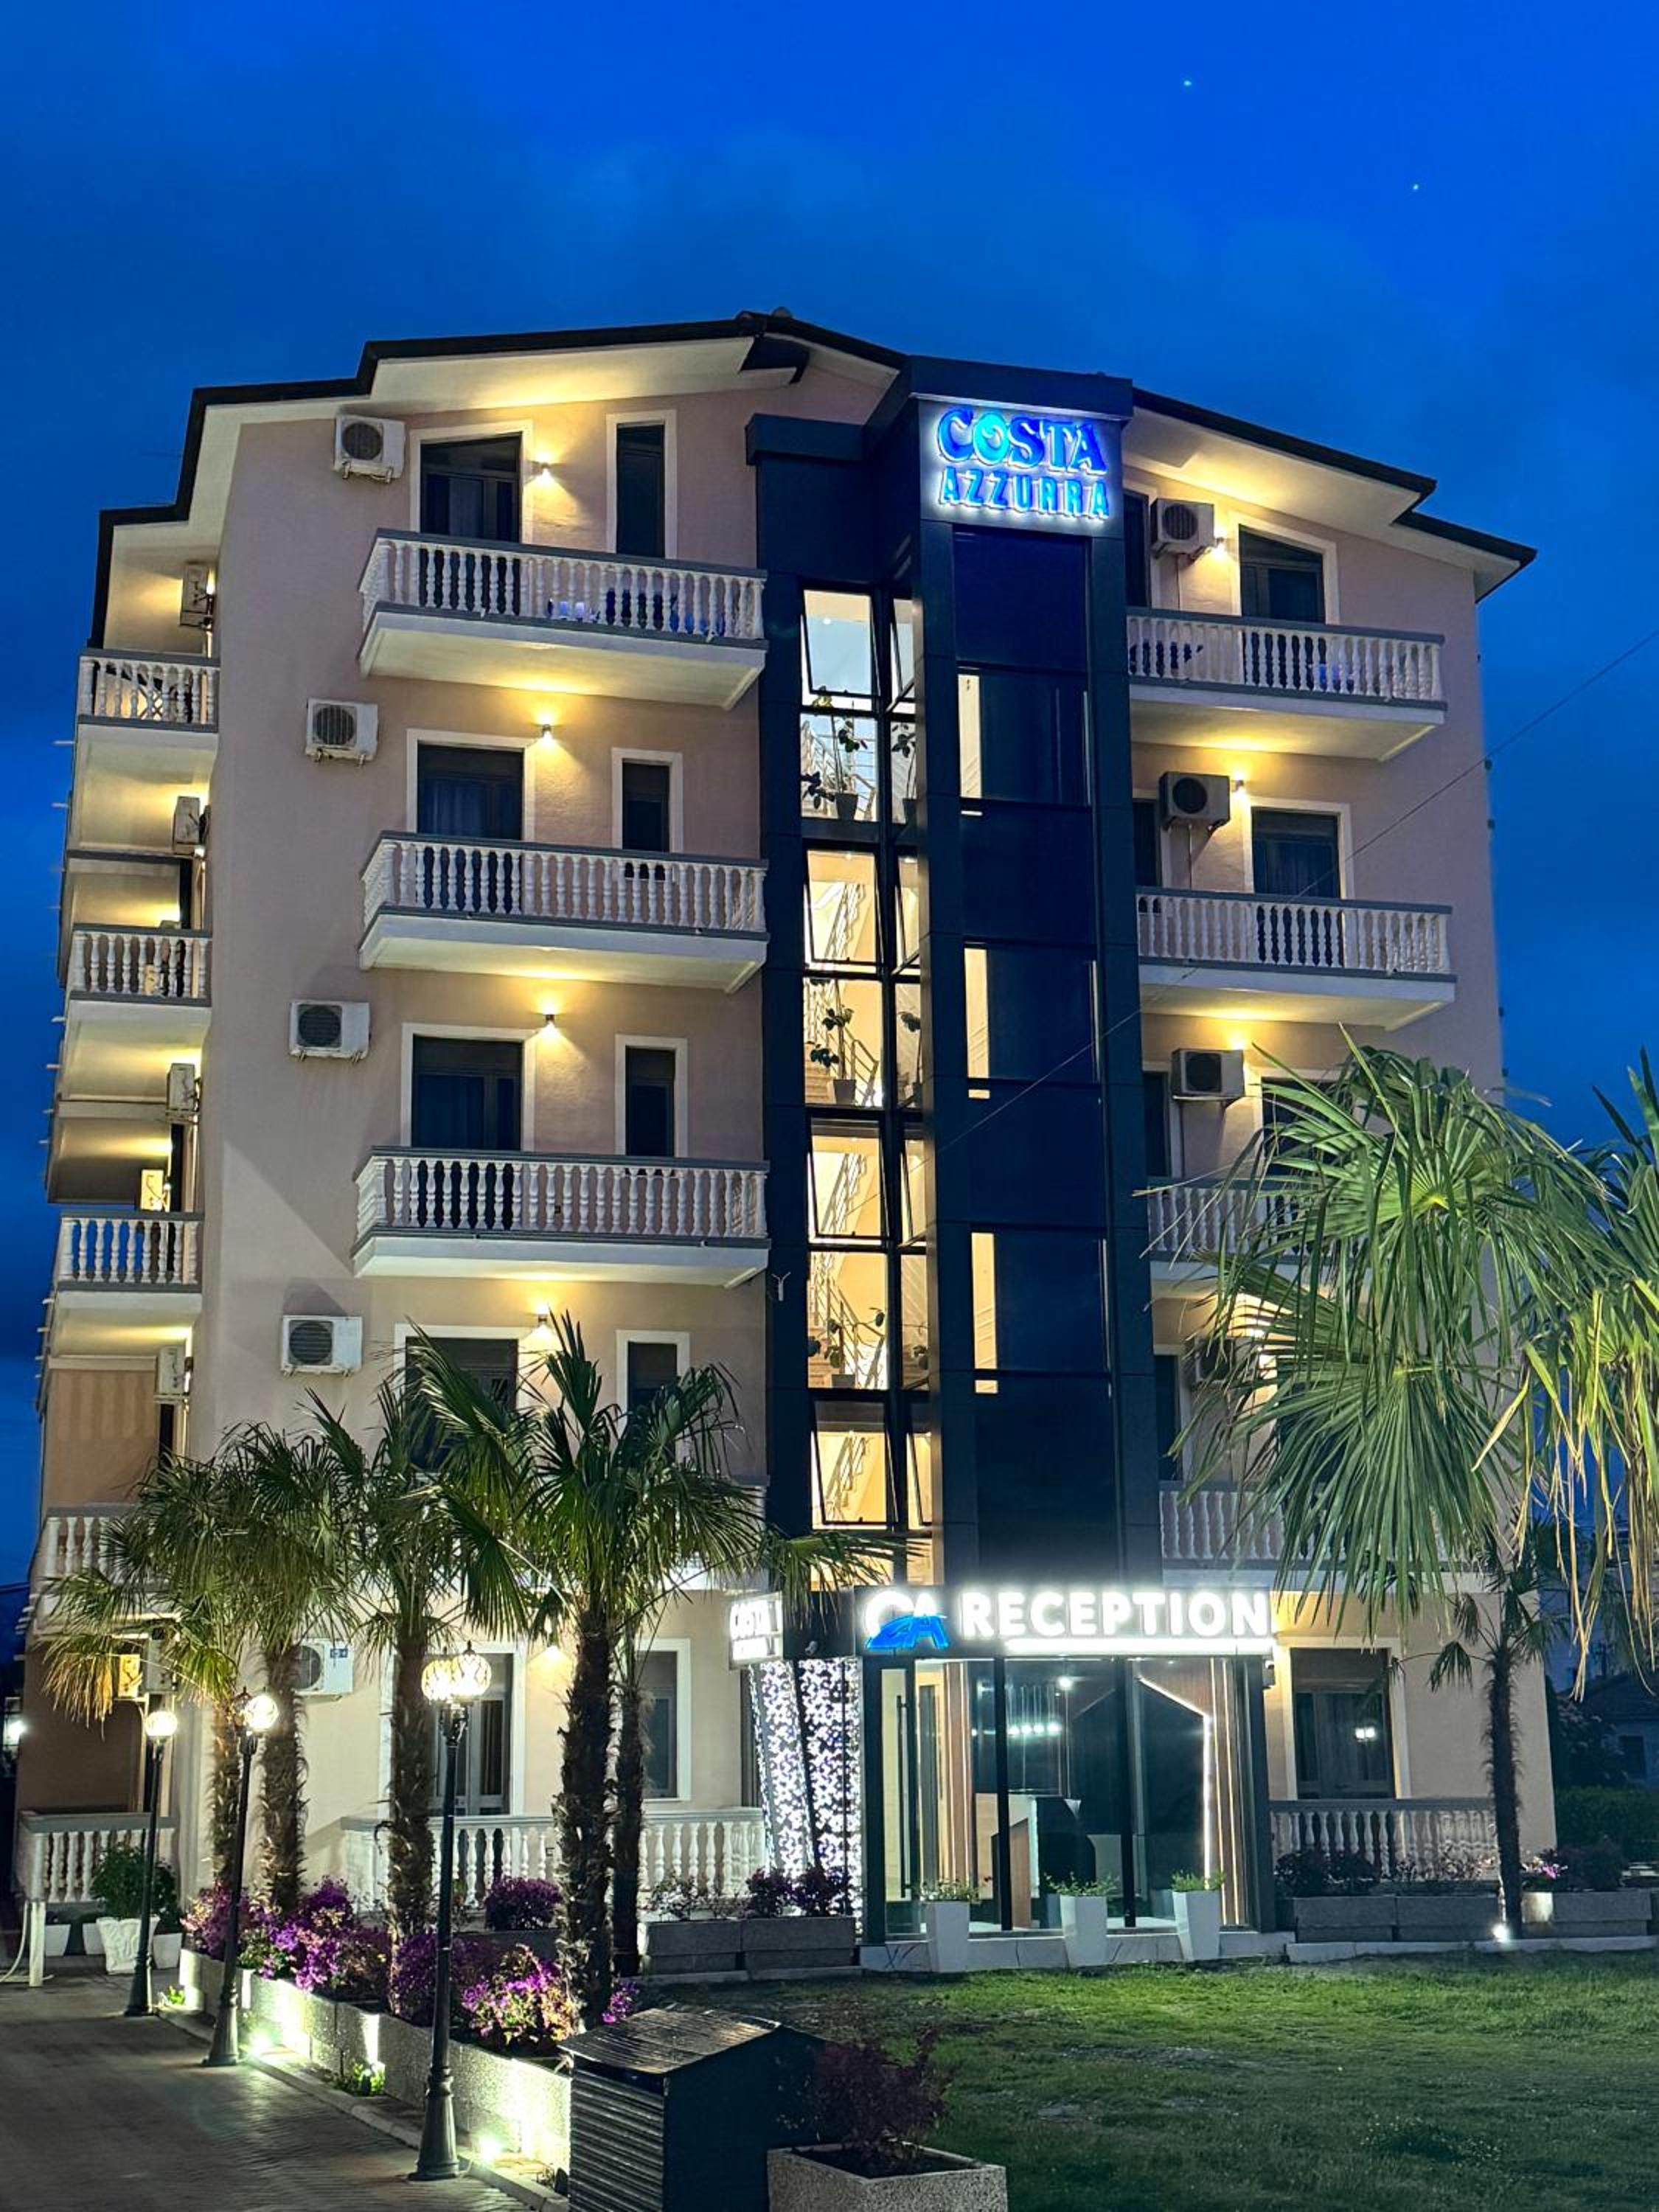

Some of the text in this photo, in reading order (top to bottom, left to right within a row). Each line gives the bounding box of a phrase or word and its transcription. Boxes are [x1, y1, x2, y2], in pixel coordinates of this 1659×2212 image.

[939, 407, 1107, 473] COSTA
[939, 466, 1109, 518] AZZURRA
[960, 1591, 1268, 1638] RECEPTION
